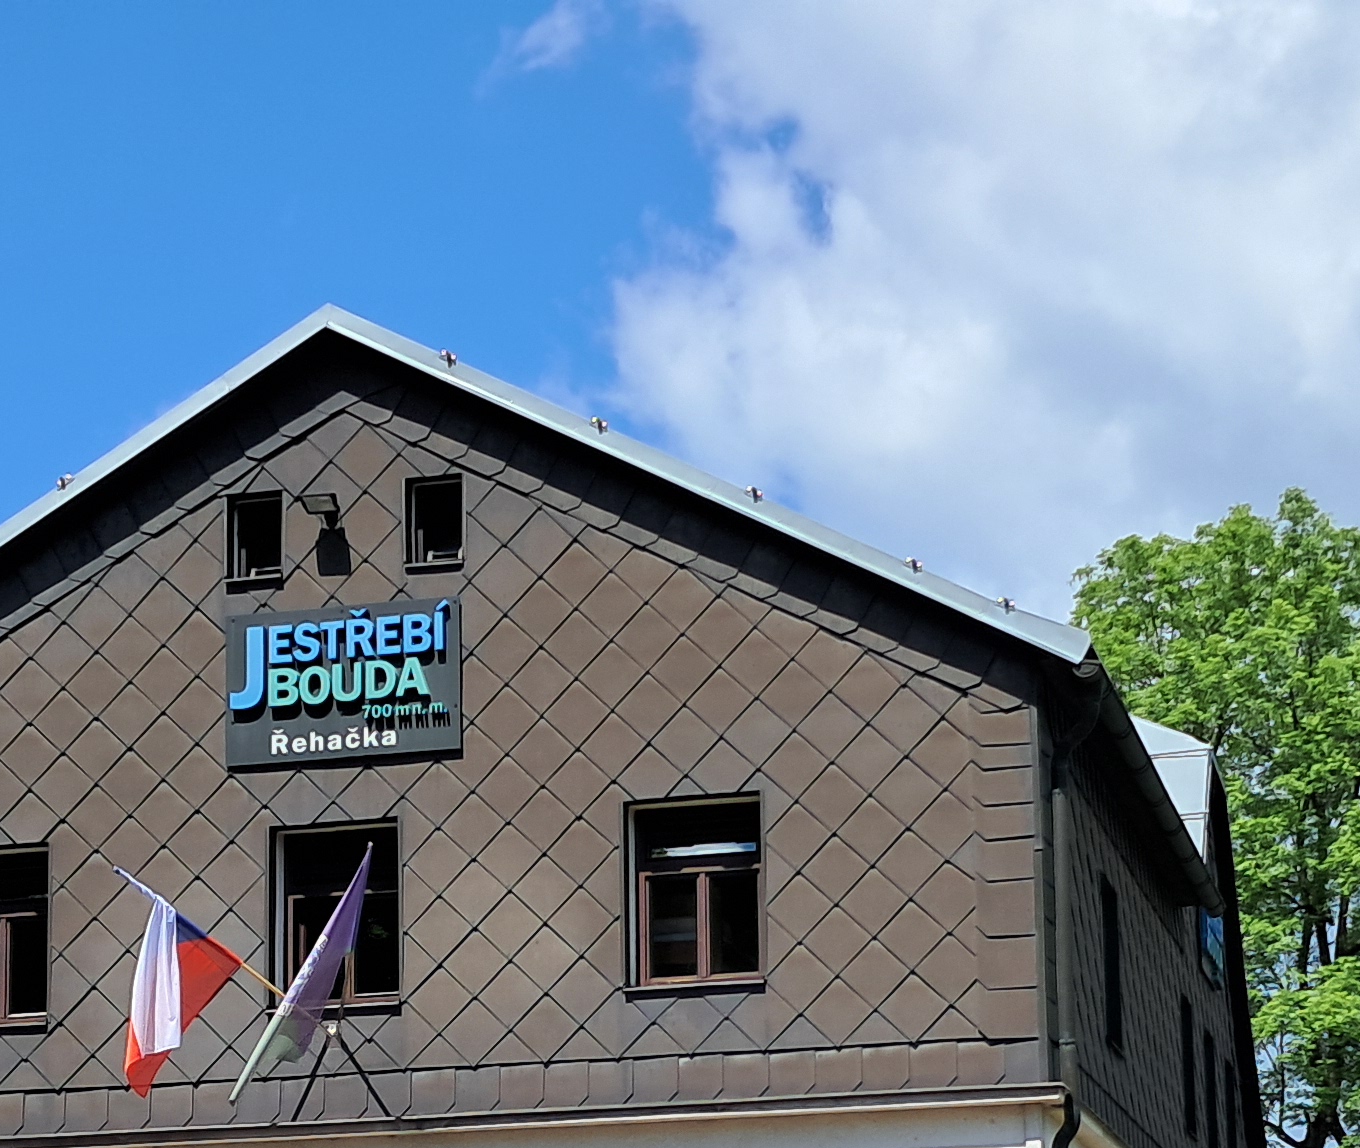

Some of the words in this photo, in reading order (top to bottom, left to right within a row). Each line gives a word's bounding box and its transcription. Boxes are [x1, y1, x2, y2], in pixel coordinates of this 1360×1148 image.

[229, 599, 448, 709] JESTŘEBÍ
[268, 657, 431, 707] BOUDA
[362, 704, 392, 719] 700
[270, 727, 397, 755] Řehačka
